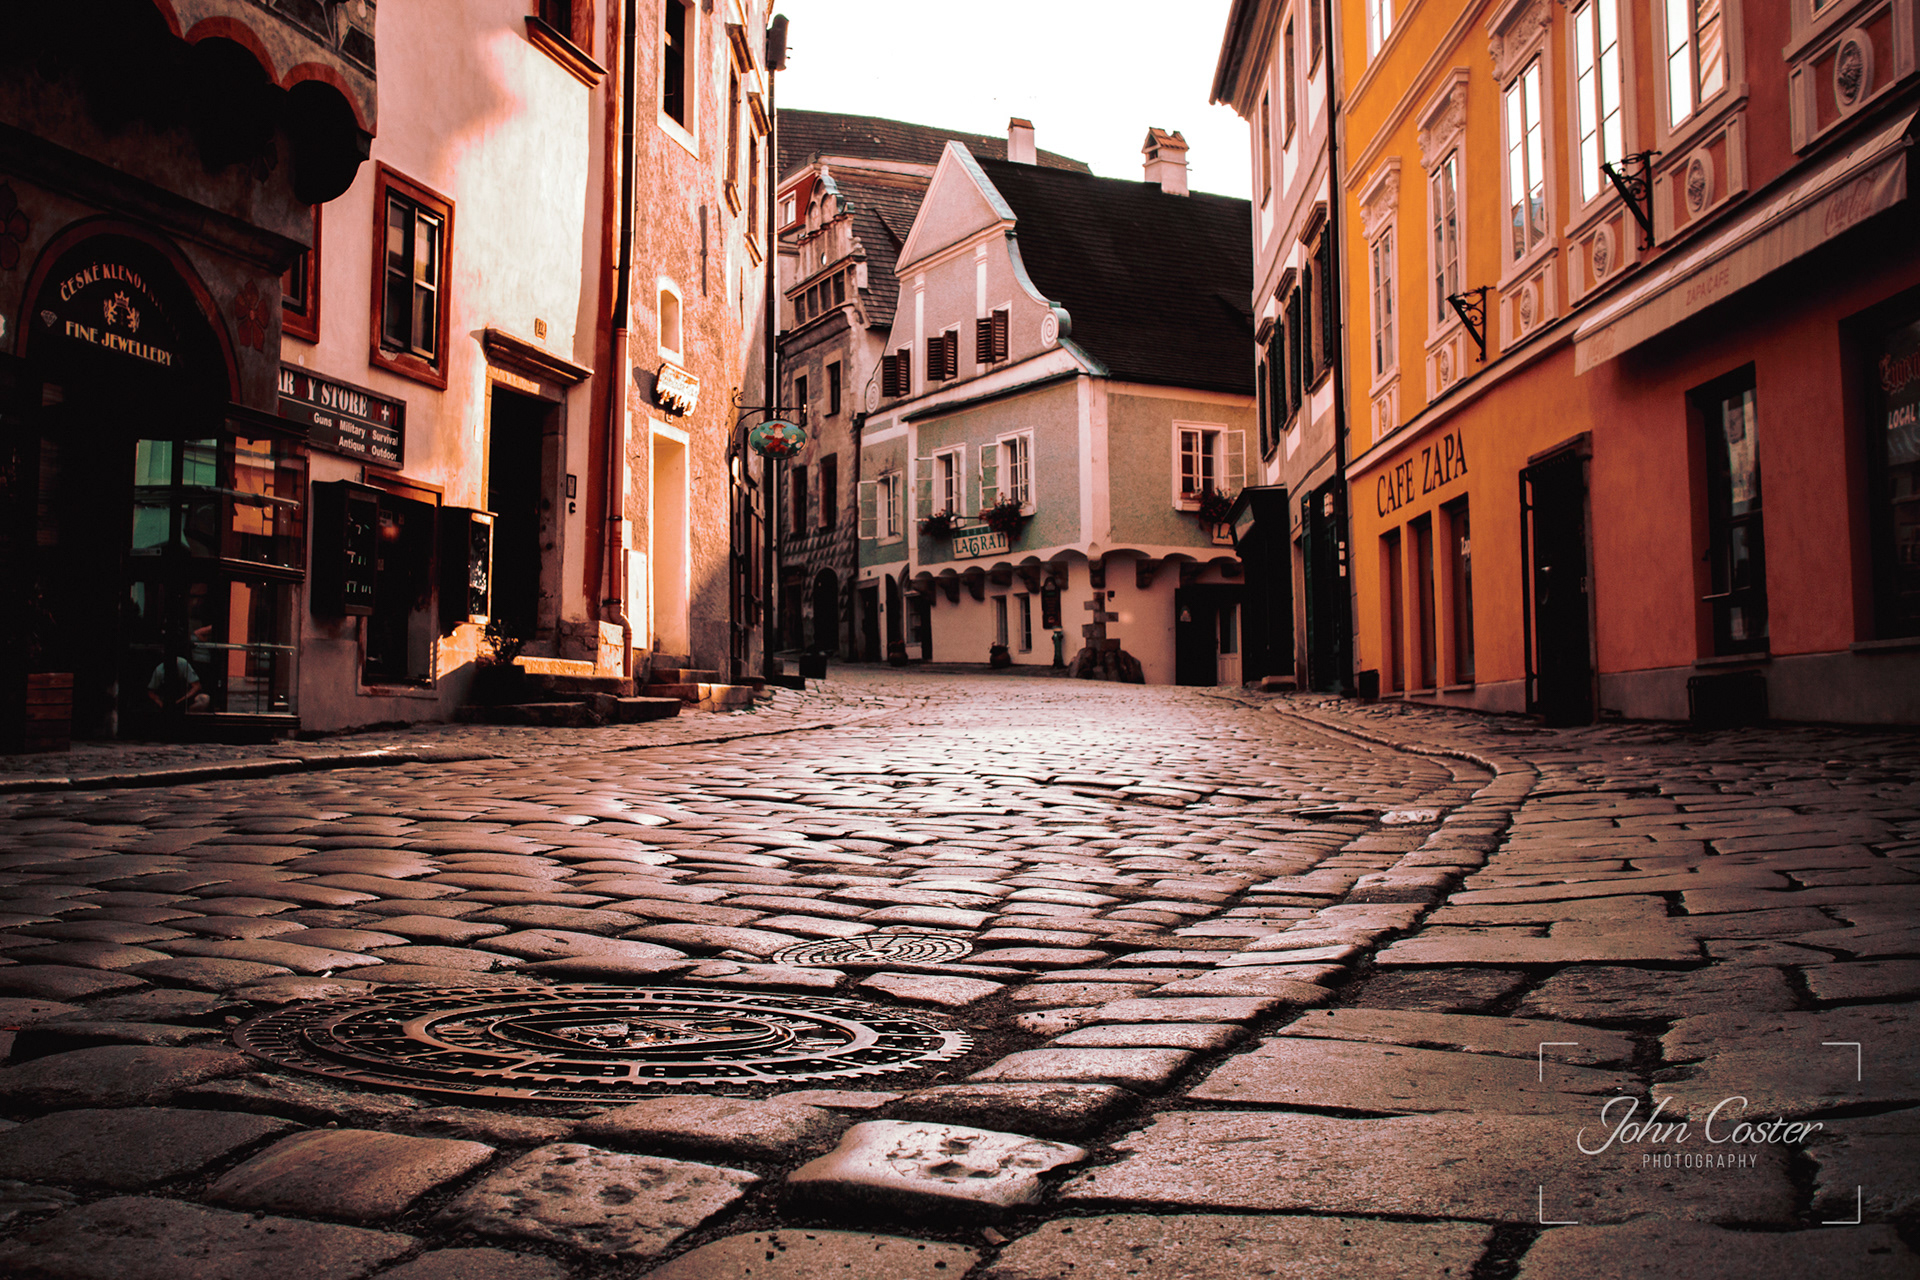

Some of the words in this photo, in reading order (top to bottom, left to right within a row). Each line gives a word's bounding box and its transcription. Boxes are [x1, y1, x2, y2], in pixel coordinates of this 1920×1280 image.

[1686, 282, 1707, 306] ZAPA
[1707, 267, 1729, 294] CAFE
[65, 320, 99, 345] FINE
[101, 331, 173, 367] JEWELLERY
[321, 382, 368, 418] STORE
[1888, 403, 1916, 430] LOCAL
[313, 412, 333, 428] Guns
[339, 420, 367, 440] Military
[372, 430, 398, 447] Survival
[338, 436, 366, 453] Antique
[371, 444, 398, 461] Outdoor
[1377, 458, 1416, 518] CAFE
[1421, 427, 1468, 495] ZAPA
